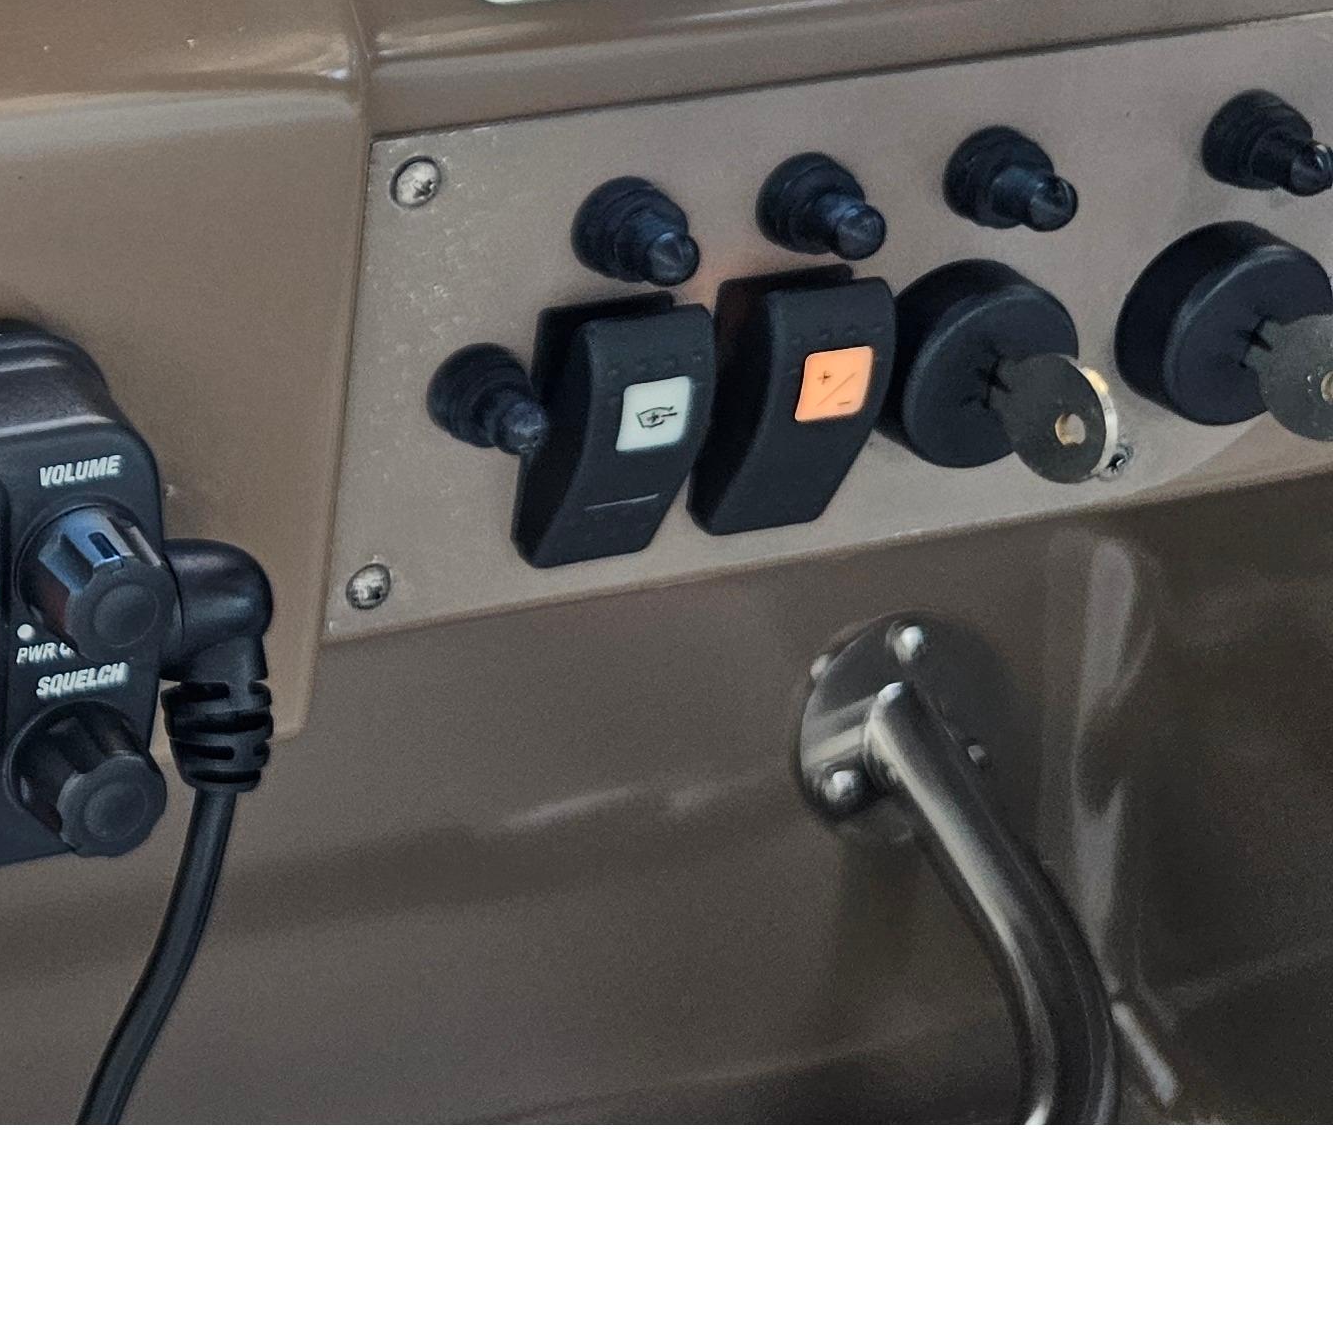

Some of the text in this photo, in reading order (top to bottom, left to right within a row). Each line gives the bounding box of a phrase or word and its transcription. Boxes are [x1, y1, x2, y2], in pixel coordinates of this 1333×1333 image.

[39, 454, 122, 487] VOLUME
[16, 642, 57, 665] PWR
[36, 661, 130, 699] SQUELCH
